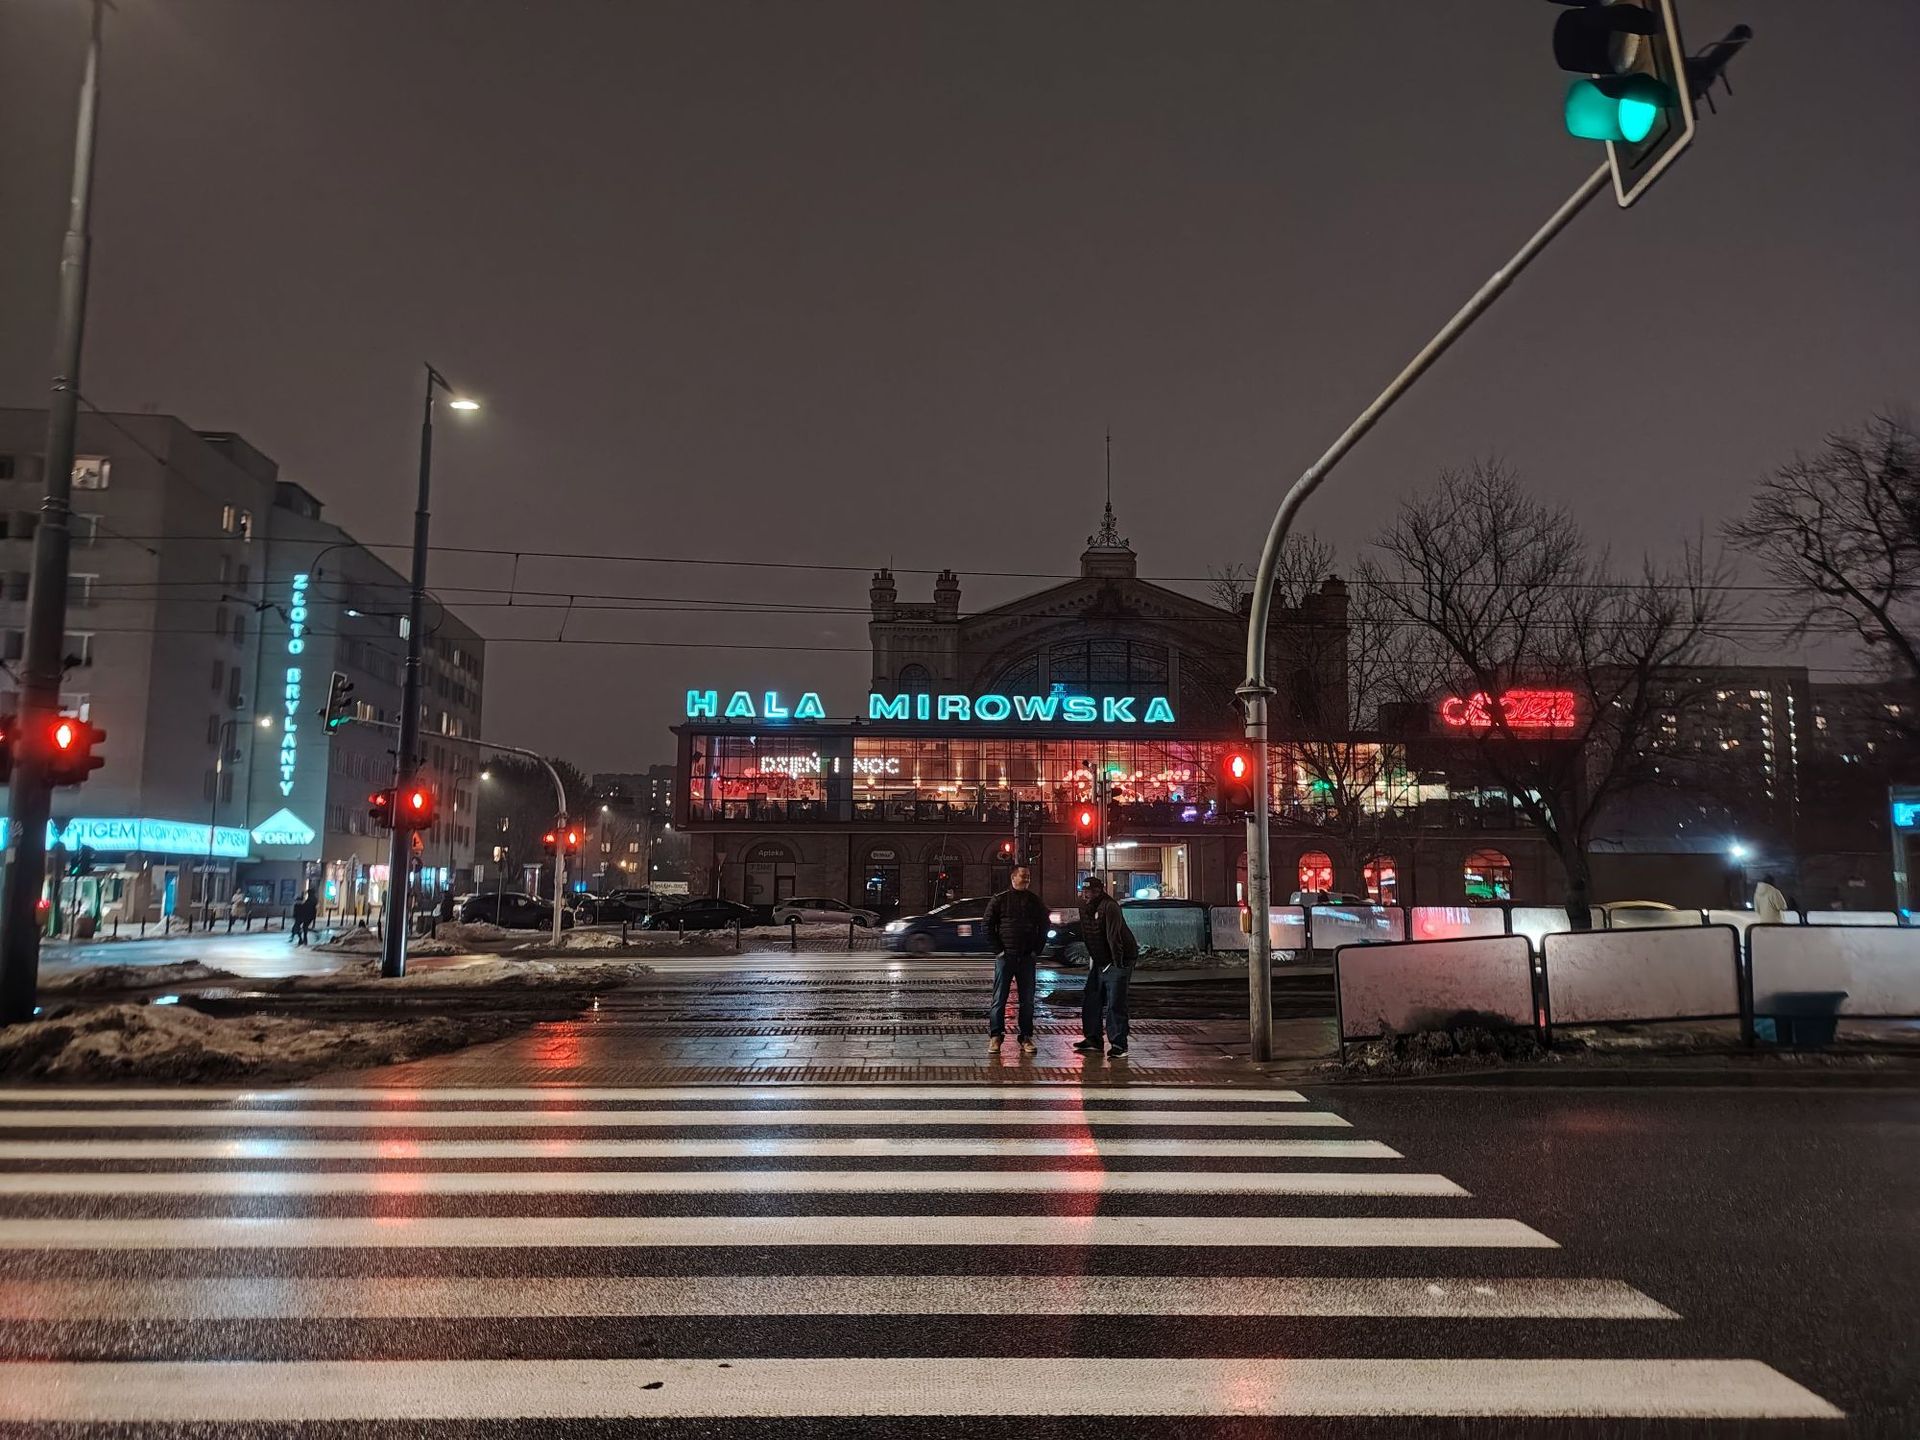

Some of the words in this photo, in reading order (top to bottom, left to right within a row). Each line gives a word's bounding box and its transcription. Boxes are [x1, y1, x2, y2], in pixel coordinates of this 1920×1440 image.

[288, 574, 309, 655] ZŁOTO
[686, 690, 826, 718] HALA
[869, 694, 1176, 723] MIROWSKA
[280, 667, 302, 797] BRYLANTY
[833, 757, 840, 773] I
[853, 757, 900, 774] NOC
[255, 831, 312, 845] FORUM
